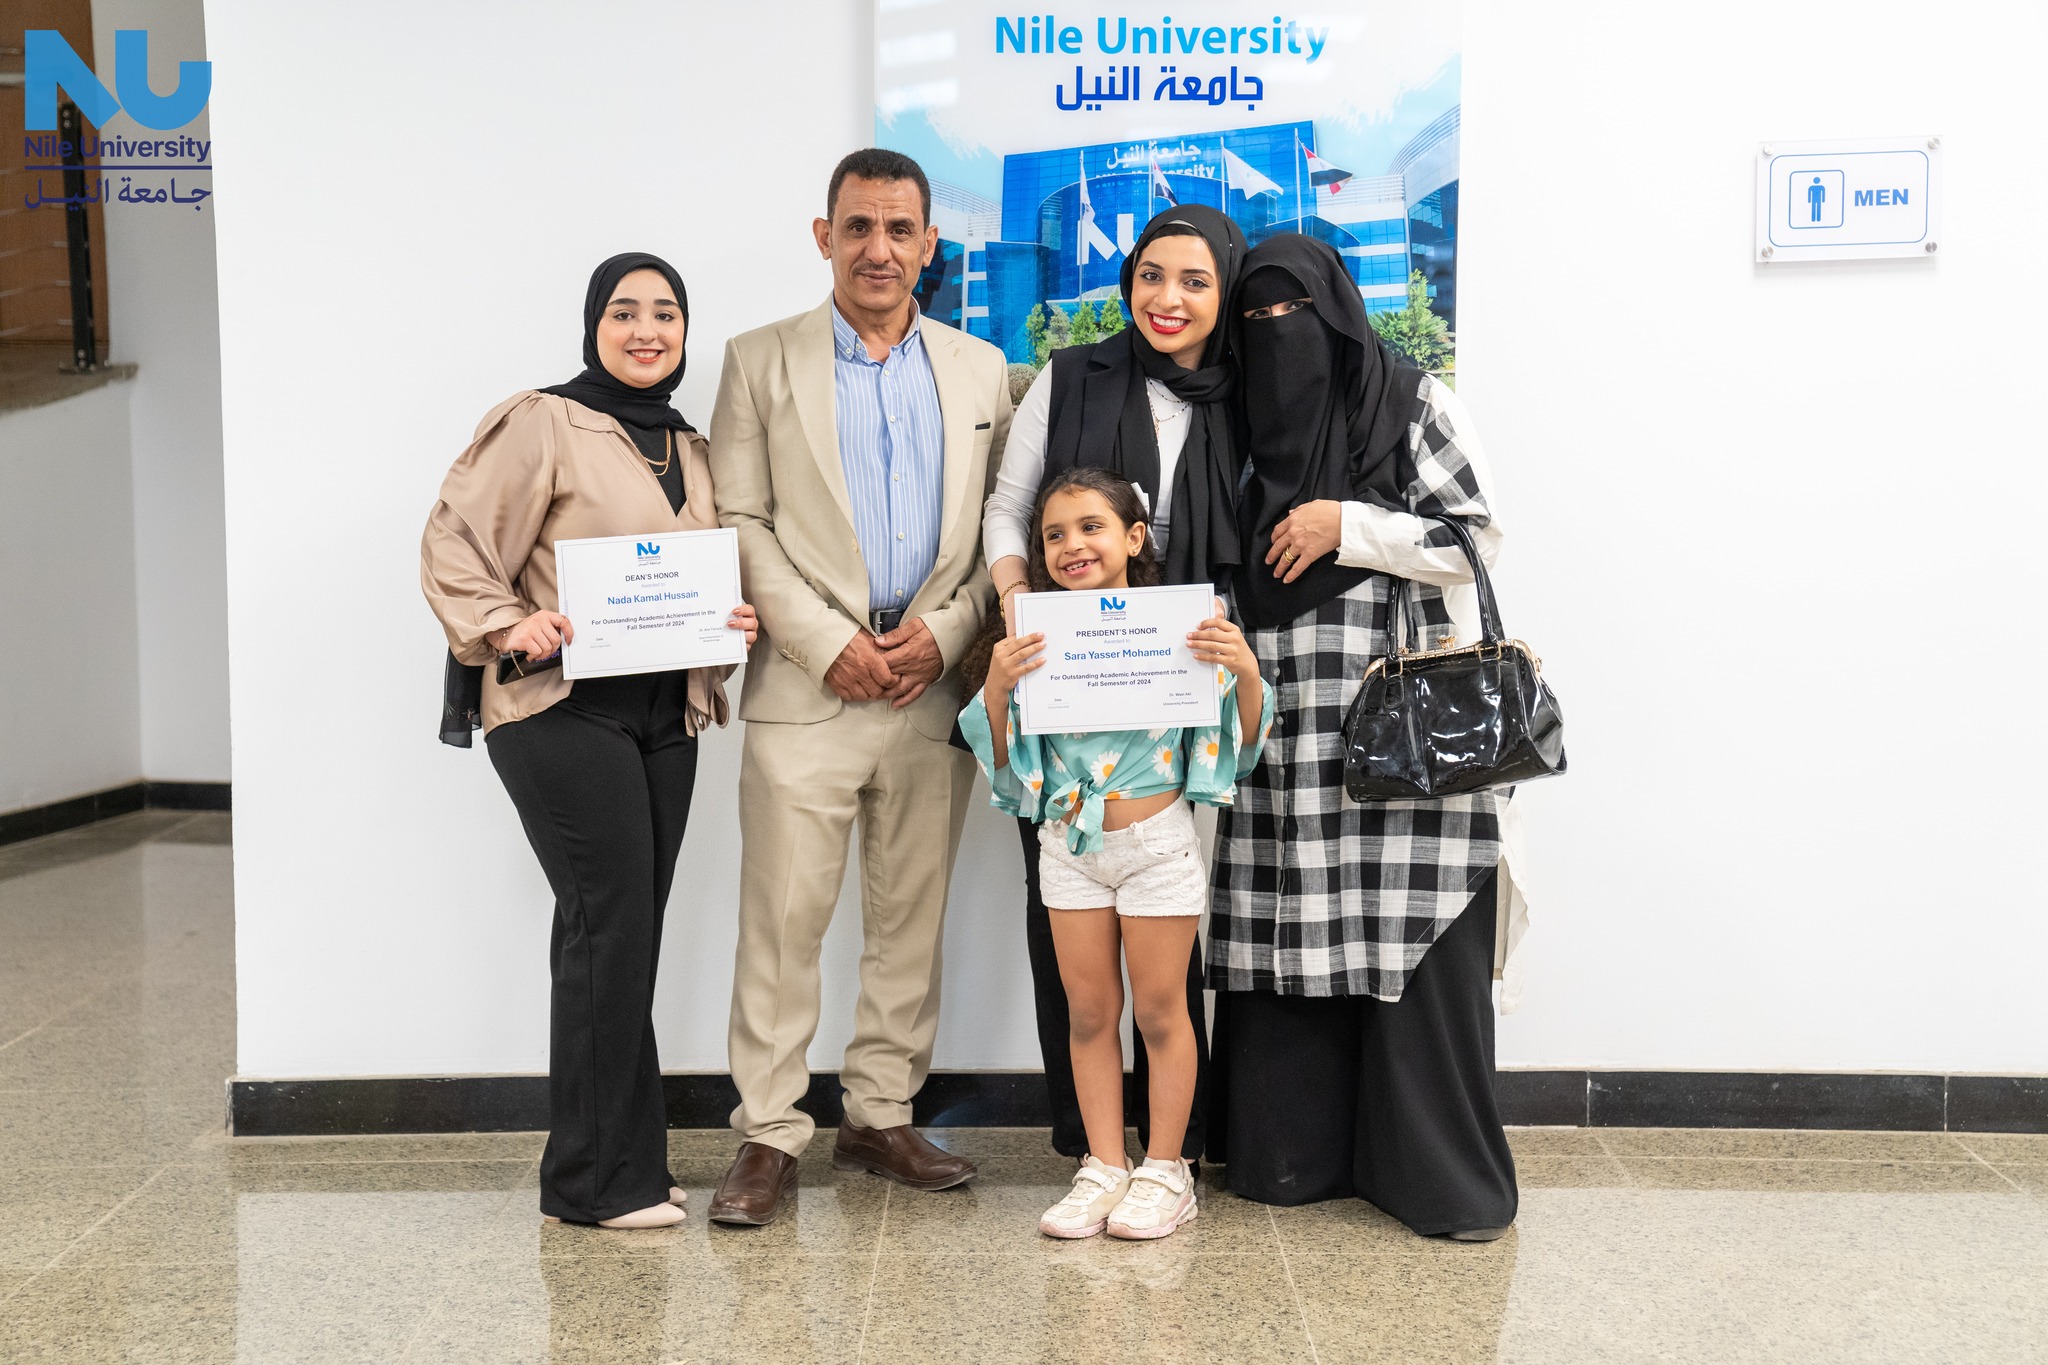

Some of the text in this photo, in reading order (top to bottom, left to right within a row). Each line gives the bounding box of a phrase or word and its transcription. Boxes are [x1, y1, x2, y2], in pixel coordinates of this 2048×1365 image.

[996, 15, 1330, 65] Nile University
[1056, 66, 1263, 111] جامعة النيل
[1106, 144, 1145, 169] النيل
[1854, 188, 1909, 207] MEN
[636, 542, 660, 556] NU
[625, 571, 679, 582] DEAN'S HONOR
[607, 589, 699, 605] Nada Kamal Hussain
[1100, 597, 1126, 611] NU
[602, 617, 638, 625] Outstanding
[666, 611, 701, 619] Achievement
[638, 622, 665, 630] Semester
[1076, 627, 1158, 638] PRESIDENT'S HONOR
[1064, 647, 1171, 660] Sara Yasser Mohamed
[1130, 669, 1169, 677] Achievement
